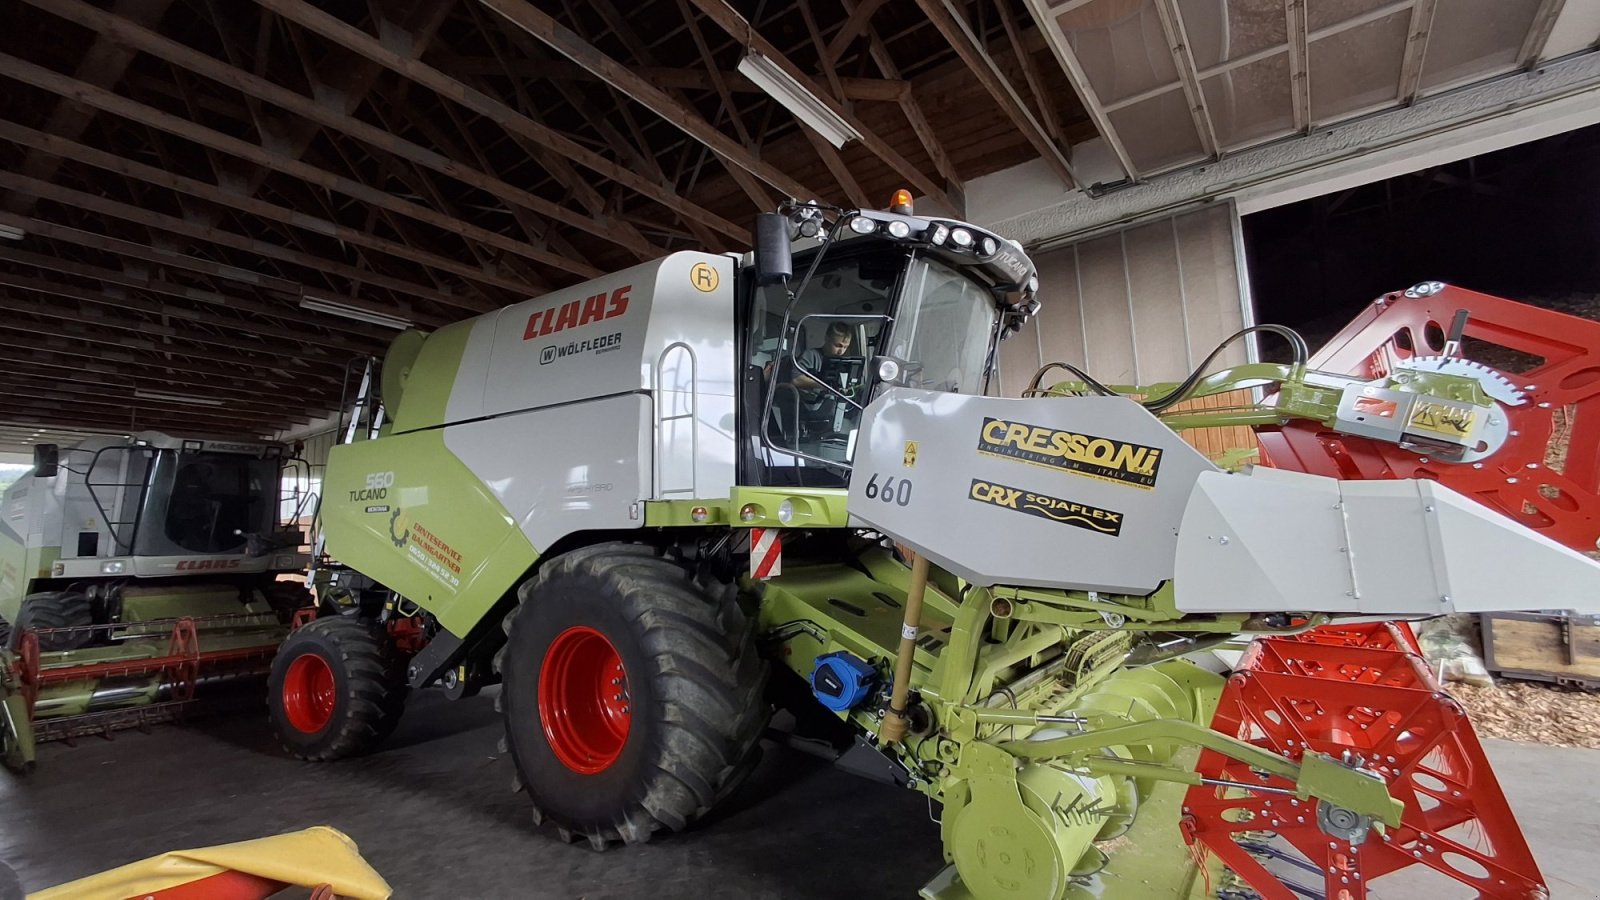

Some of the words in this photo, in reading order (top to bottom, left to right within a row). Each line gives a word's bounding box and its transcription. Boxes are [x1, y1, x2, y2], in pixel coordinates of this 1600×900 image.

[697, 267, 711, 287] R
[1000, 251, 1027, 277] TUCANO
[523, 285, 632, 341] CLAAS
[558, 332, 622, 358] WÖLFLEDER
[980, 443, 1056, 464] ENGINEERING
[1097, 467, 1127, 479] ITALY
[1140, 476, 1154, 485] EU
[349, 488, 387, 502] TUCANO
[366, 472, 394, 489] 560
[865, 472, 912, 507] 660
[971, 482, 1024, 508] CRX
[1025, 494, 1119, 523] SOJAFLEX
[411, 534, 461, 574] BAUMGARTNER
[413, 522, 463, 562] ERNTESERVICE
[176, 559, 241, 571] CLAAS
